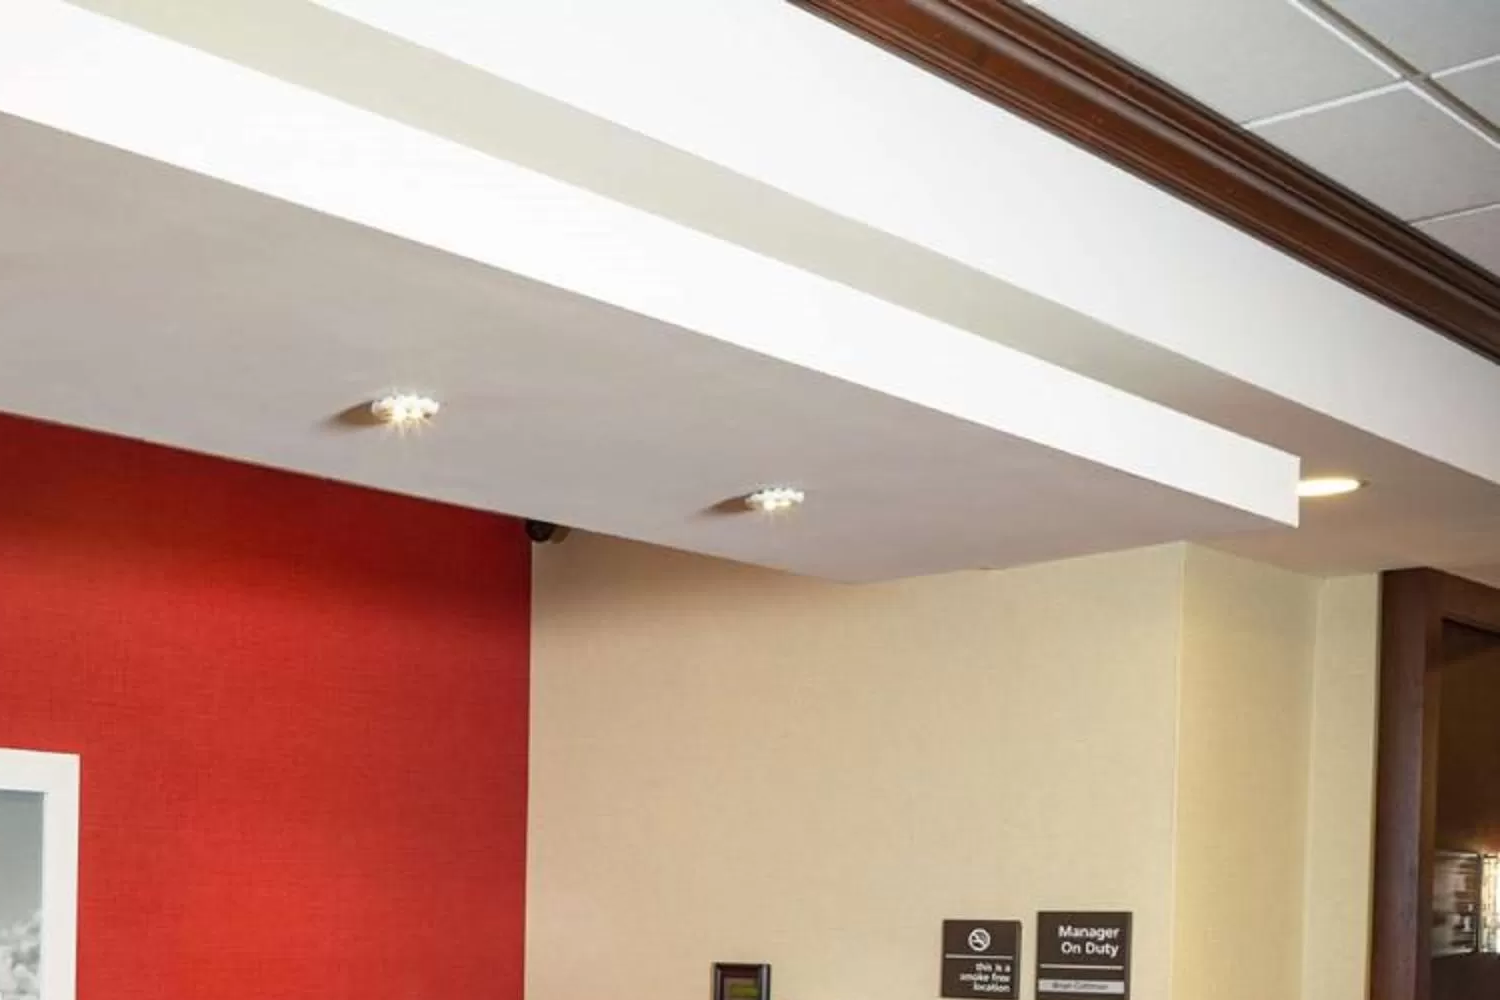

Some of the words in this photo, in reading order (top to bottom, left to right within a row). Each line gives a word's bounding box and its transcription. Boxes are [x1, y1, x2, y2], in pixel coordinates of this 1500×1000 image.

[1057, 925, 1121, 941] Manager
[1061, 941, 1081, 955] On
[1085, 941, 1119, 958] Duty
[975, 961, 992, 972] this
[995, 963, 1003, 973] is
[959, 971, 989, 982] smoke
[991, 972, 1011, 983] free
[973, 981, 1011, 993] location
